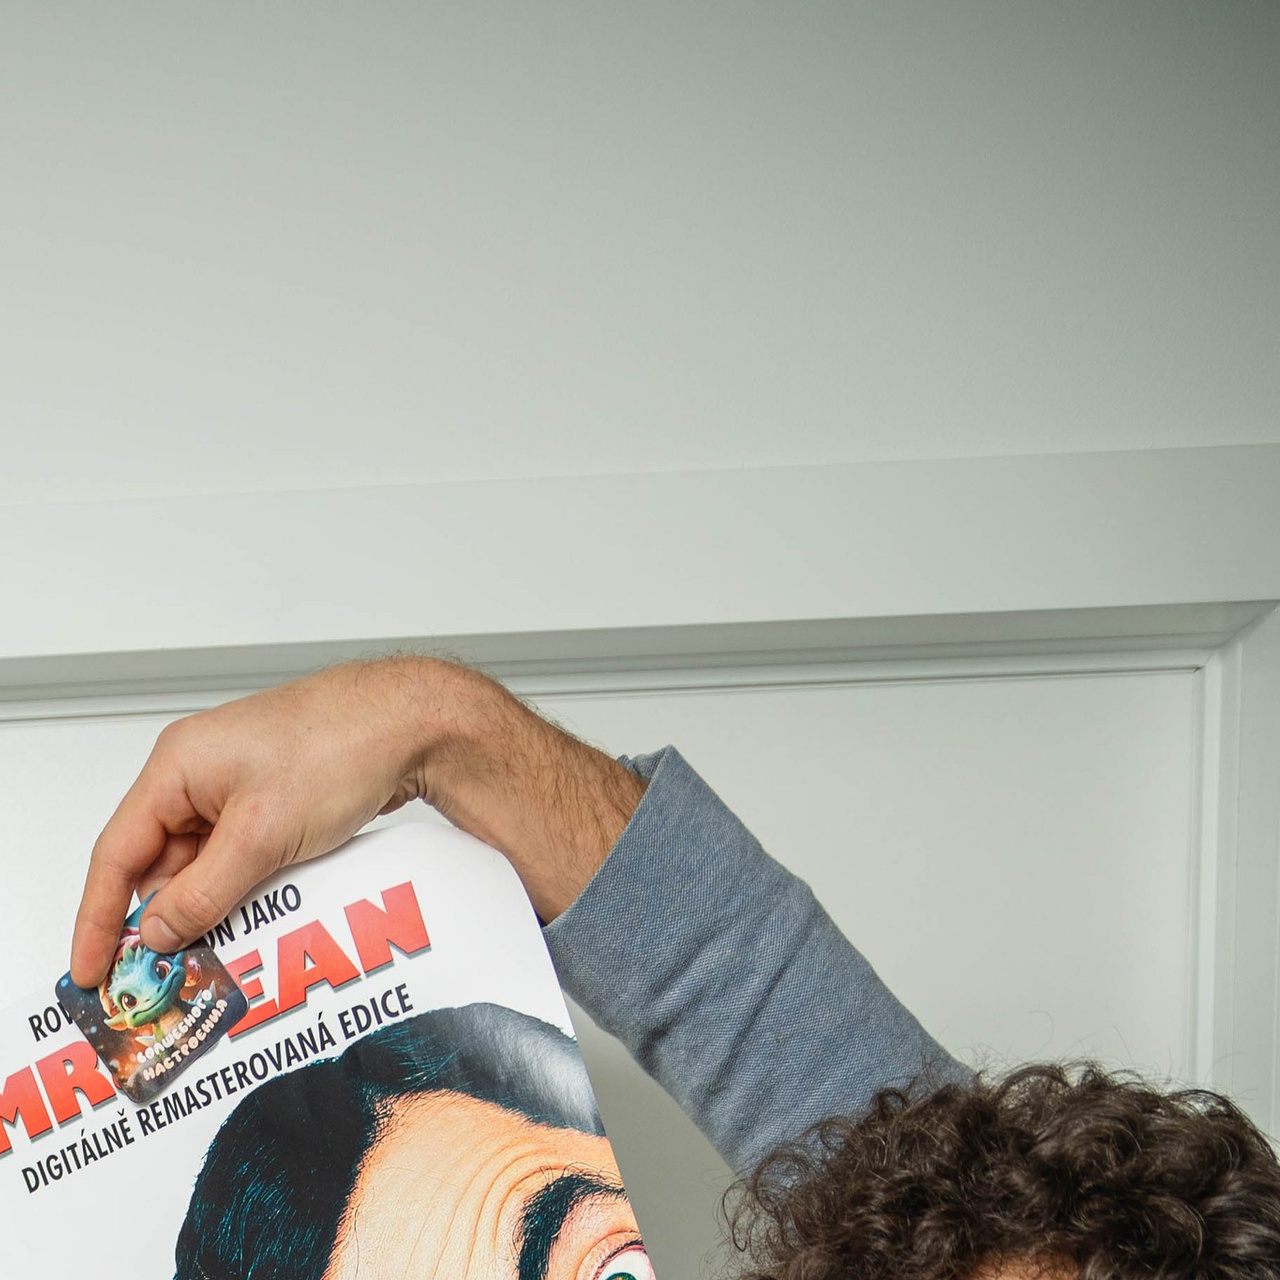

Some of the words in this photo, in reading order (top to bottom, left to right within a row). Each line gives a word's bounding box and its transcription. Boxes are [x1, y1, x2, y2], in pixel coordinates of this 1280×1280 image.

[228, 881, 431, 1040] EAN
[242, 884, 302, 936] JAKO
[21, 1110, 135, 1194] DIGITÁLNĚ
[138, 1010, 337, 1133] REMASTEROVANÁ
[342, 983, 414, 1041] EDICE
[143, 999, 228, 1081] НАСТРОЕНИЯ
